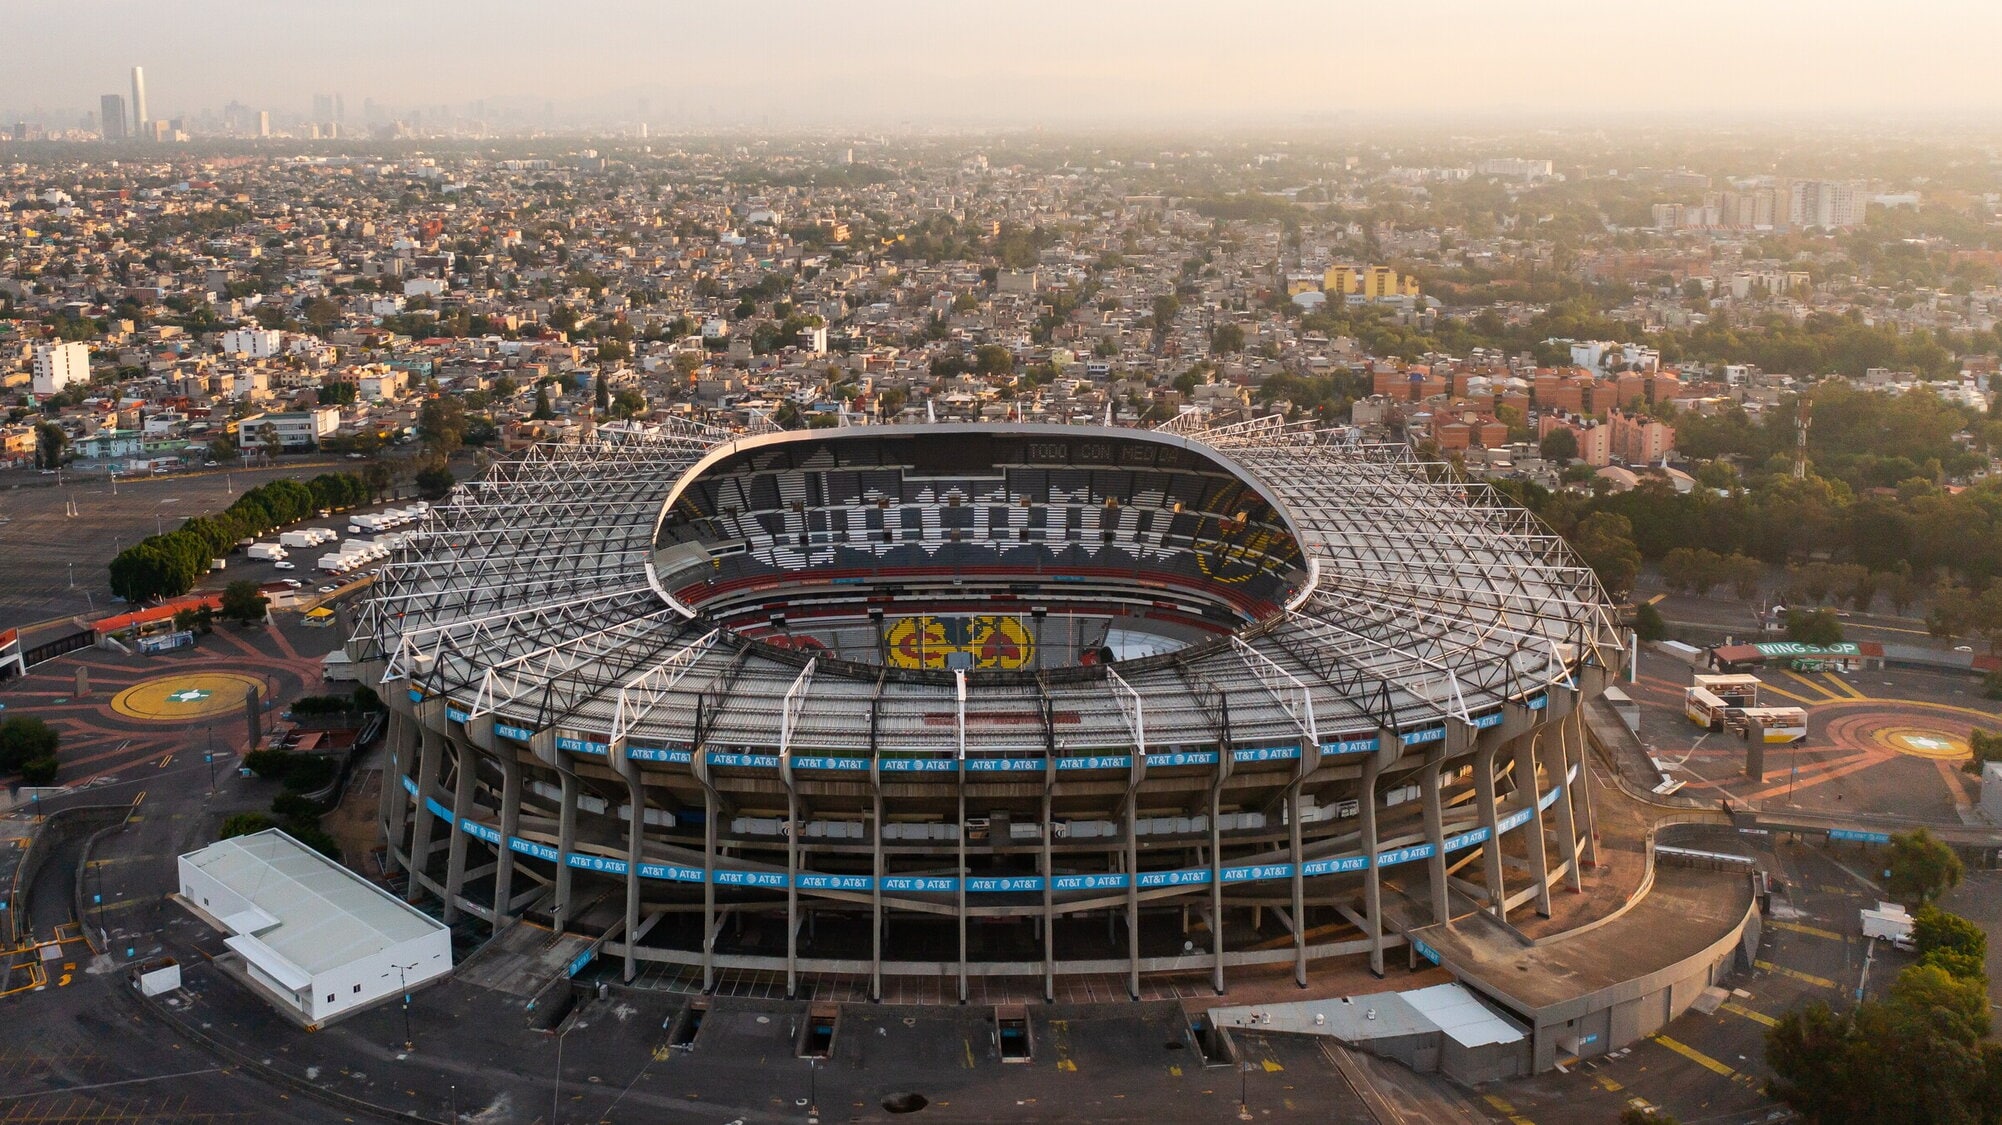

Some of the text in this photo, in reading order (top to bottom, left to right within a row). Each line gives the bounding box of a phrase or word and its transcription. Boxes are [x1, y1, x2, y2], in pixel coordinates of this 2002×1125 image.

[1481, 716, 1498, 727] AT&T
[499, 726, 517, 737] AT&T
[1422, 729, 1441, 741] AT&T
[561, 740, 582, 751] AT&T
[1350, 740, 1373, 751] AT&T
[631, 749, 655, 759] AT&T
[1147, 753, 1211, 765] AT&T AT&T
[1270, 748, 1294, 758] AT&T
[714, 754, 778, 766] AT&T AT&T
[798, 758, 863, 769] AT&T AT&T
[885, 760, 950, 770] AT&T AT&T
[972, 760, 1038, 770] AT&T AT&T
[1059, 757, 1125, 768] AT&T AT&T
[463, 821, 477, 833] AT&T
[1443, 830, 1486, 851] AT&T AT&T
[512, 840, 557, 860] AT&T AT&T
[1378, 846, 1430, 865] AT&T AT&T
[569, 856, 626, 872] AT&T AT&T
[1305, 858, 1364, 873] AT&T AT&T
[642, 866, 702, 880] AT&T AT&T
[1142, 871, 1205, 884] AT&T AT&T
[1225, 866, 1287, 879] AT&T AT&T
[719, 873, 782, 885] AT&T AT&T
[803, 877, 867, 888] AT&T AT&T
[886, 879, 951, 889] AT&T AT&T
[972, 879, 1037, 889] AT&T AT&T
[1057, 876, 1122, 888] AT&T AT&T
